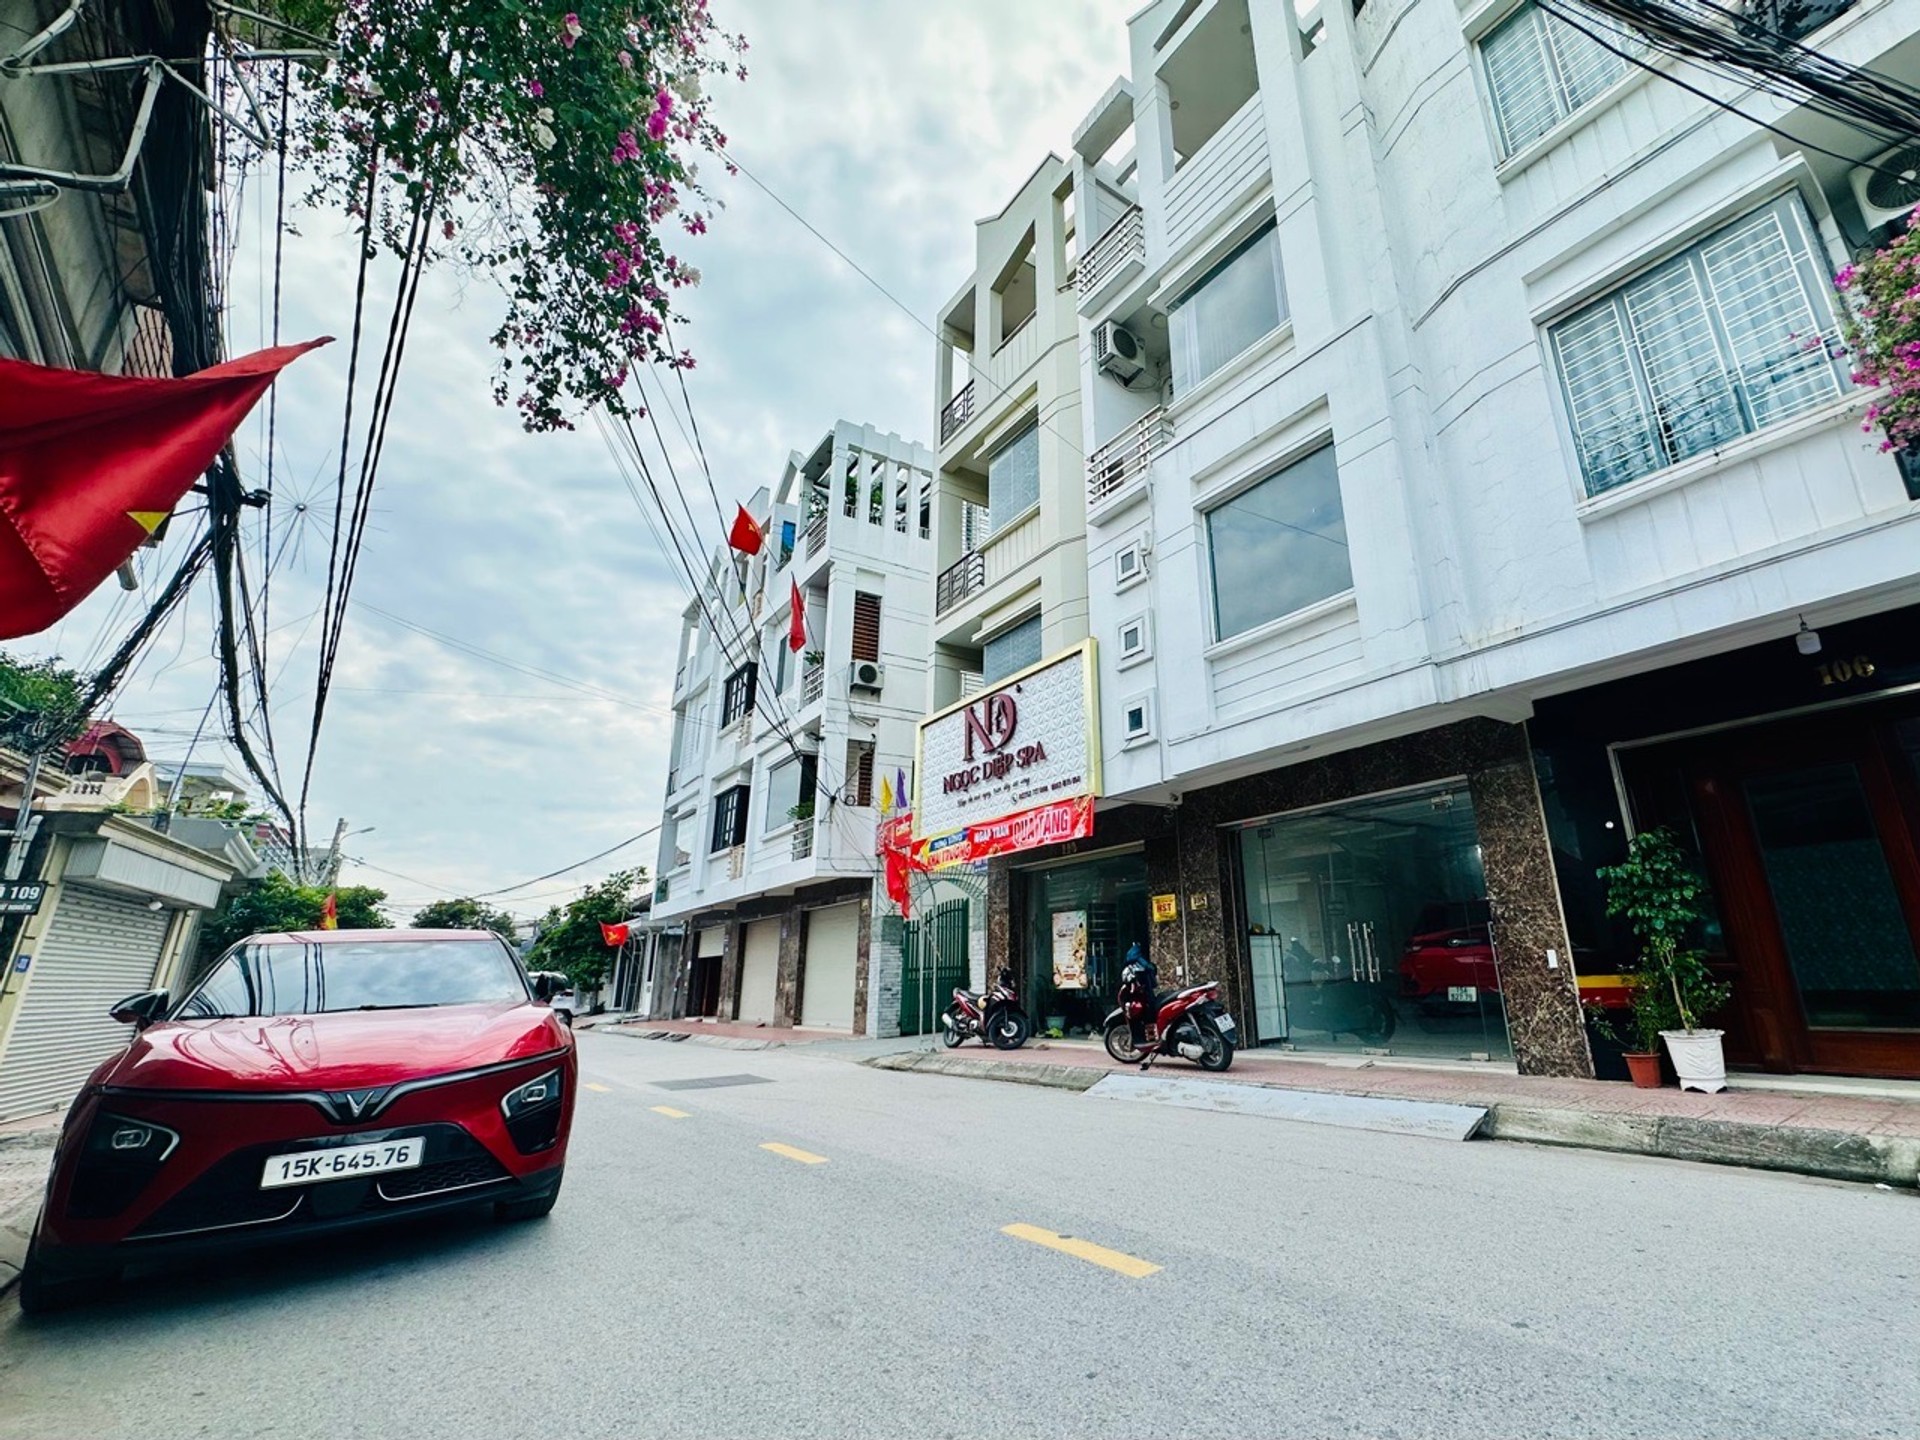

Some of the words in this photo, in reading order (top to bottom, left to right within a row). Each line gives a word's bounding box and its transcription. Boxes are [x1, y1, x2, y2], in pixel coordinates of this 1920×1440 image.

[1817, 656, 1875, 685] 106
[943, 765, 981, 795] NGỌC
[1016, 741, 1047, 769] SPA
[11, 886, 40, 900] 109
[281, 1145, 411, 1180] 15K-645.76
